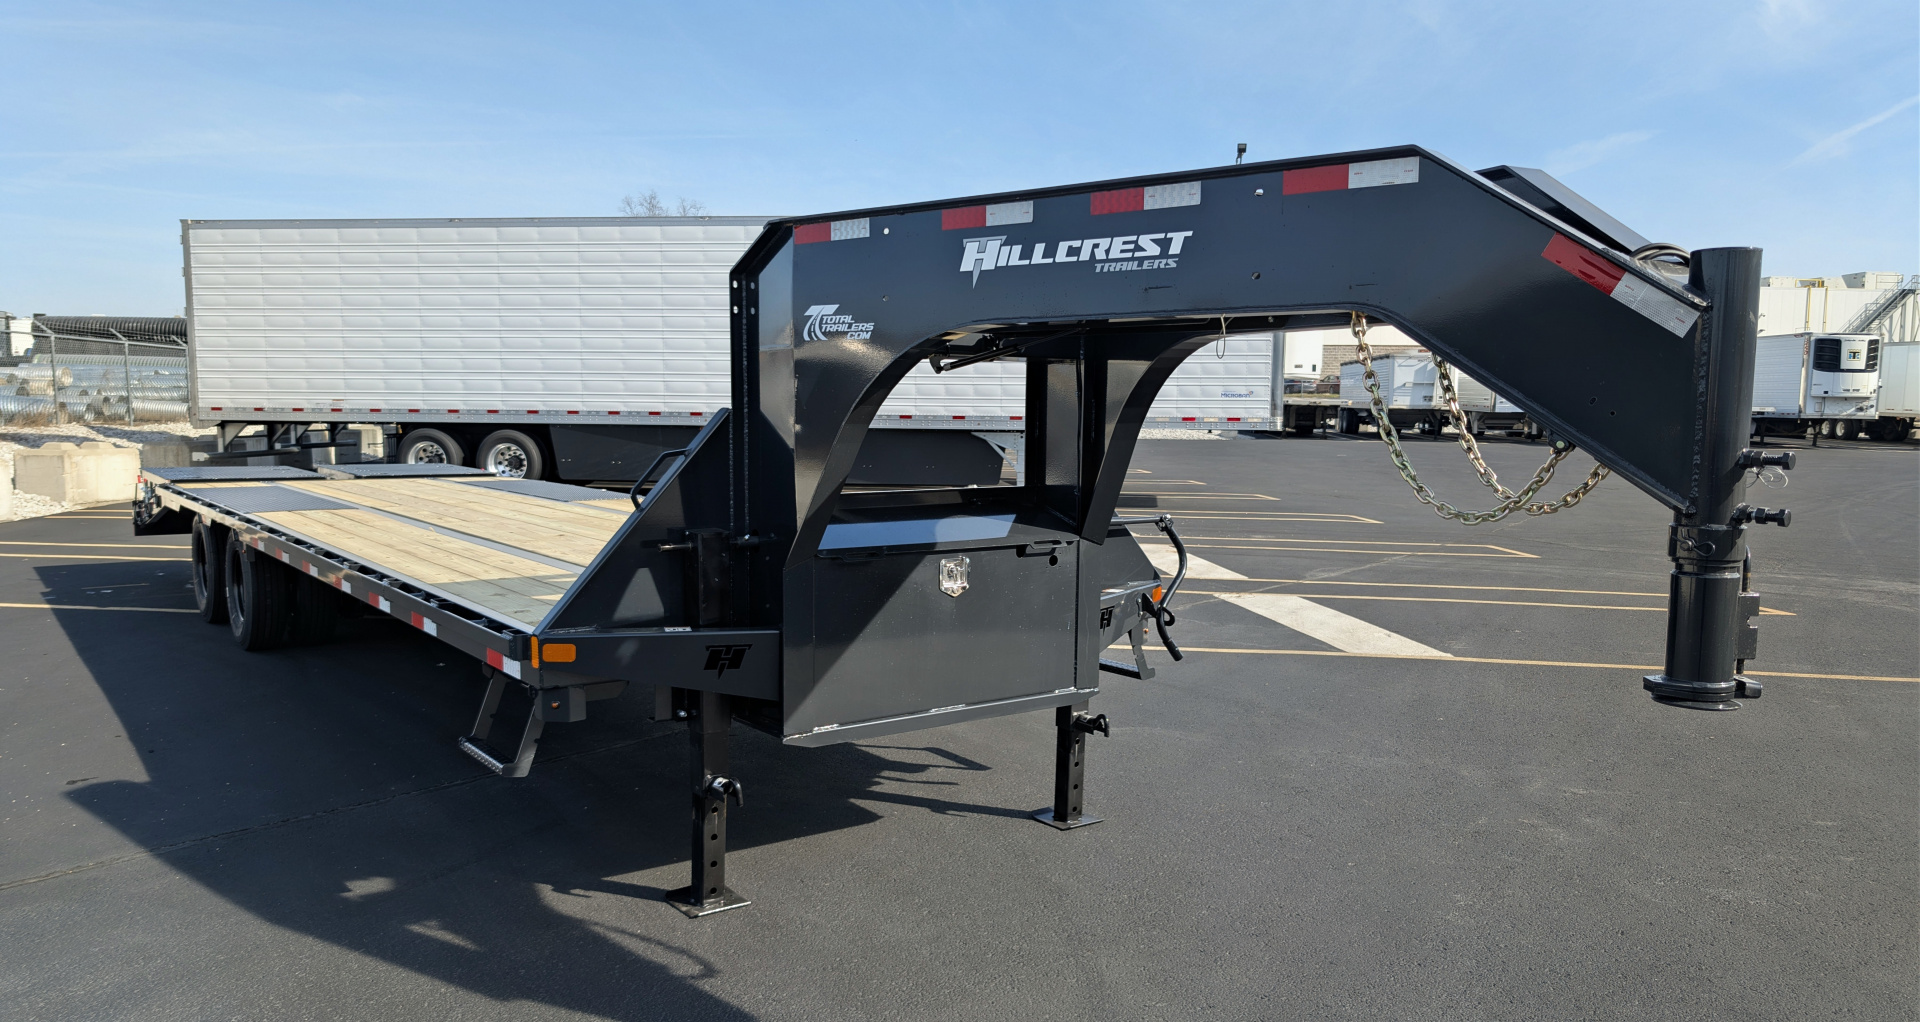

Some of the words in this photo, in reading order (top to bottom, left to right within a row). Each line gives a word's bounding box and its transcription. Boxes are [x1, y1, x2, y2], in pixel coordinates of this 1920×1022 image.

[960, 231, 1193, 277] HILLCREST
[1095, 258, 1179, 272] TRAILERS
[822, 315, 855, 324] TOTAL
[822, 323, 875, 332] TRAILERS
[847, 332, 872, 341] COM
